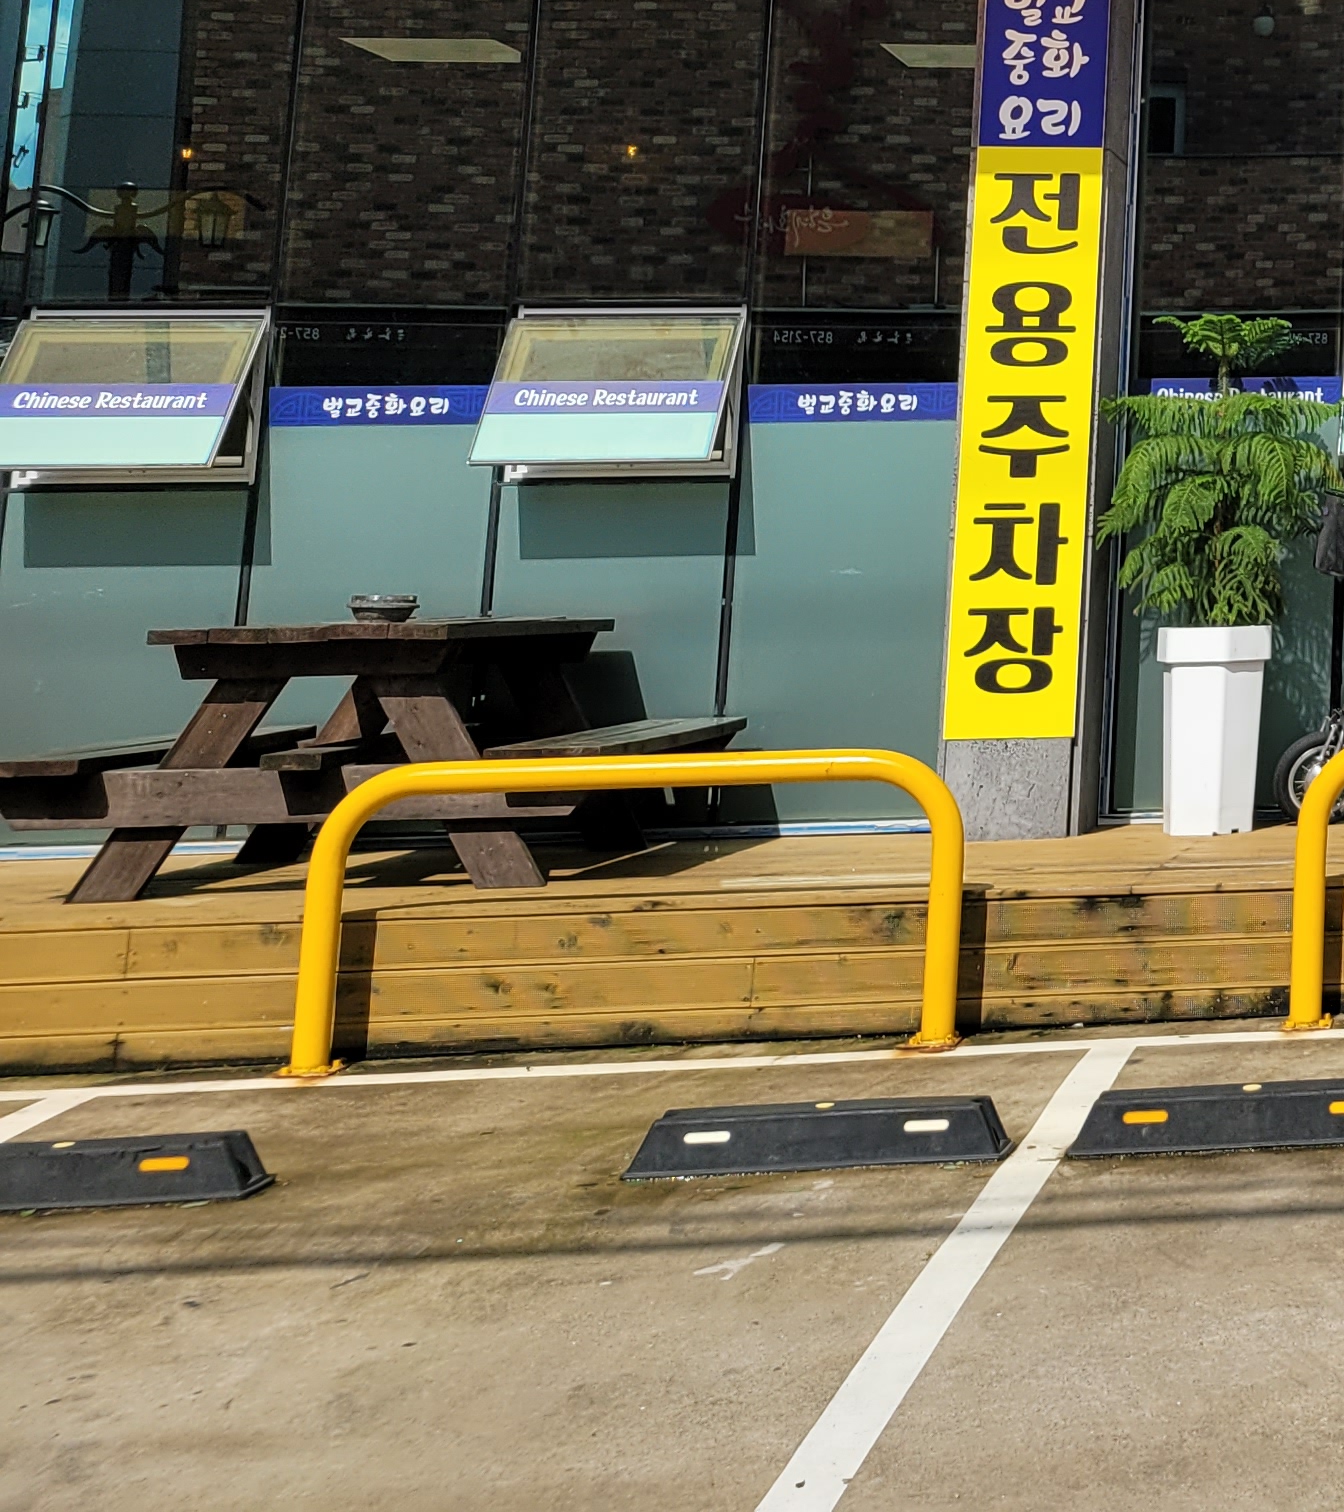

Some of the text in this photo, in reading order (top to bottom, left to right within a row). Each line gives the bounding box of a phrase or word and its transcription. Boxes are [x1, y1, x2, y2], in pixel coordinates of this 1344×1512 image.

[997, 95, 1082, 141] 요리
[12, 390, 209, 410] Chinese Restaurant
[513, 388, 699, 407] Chinese Restaurant
